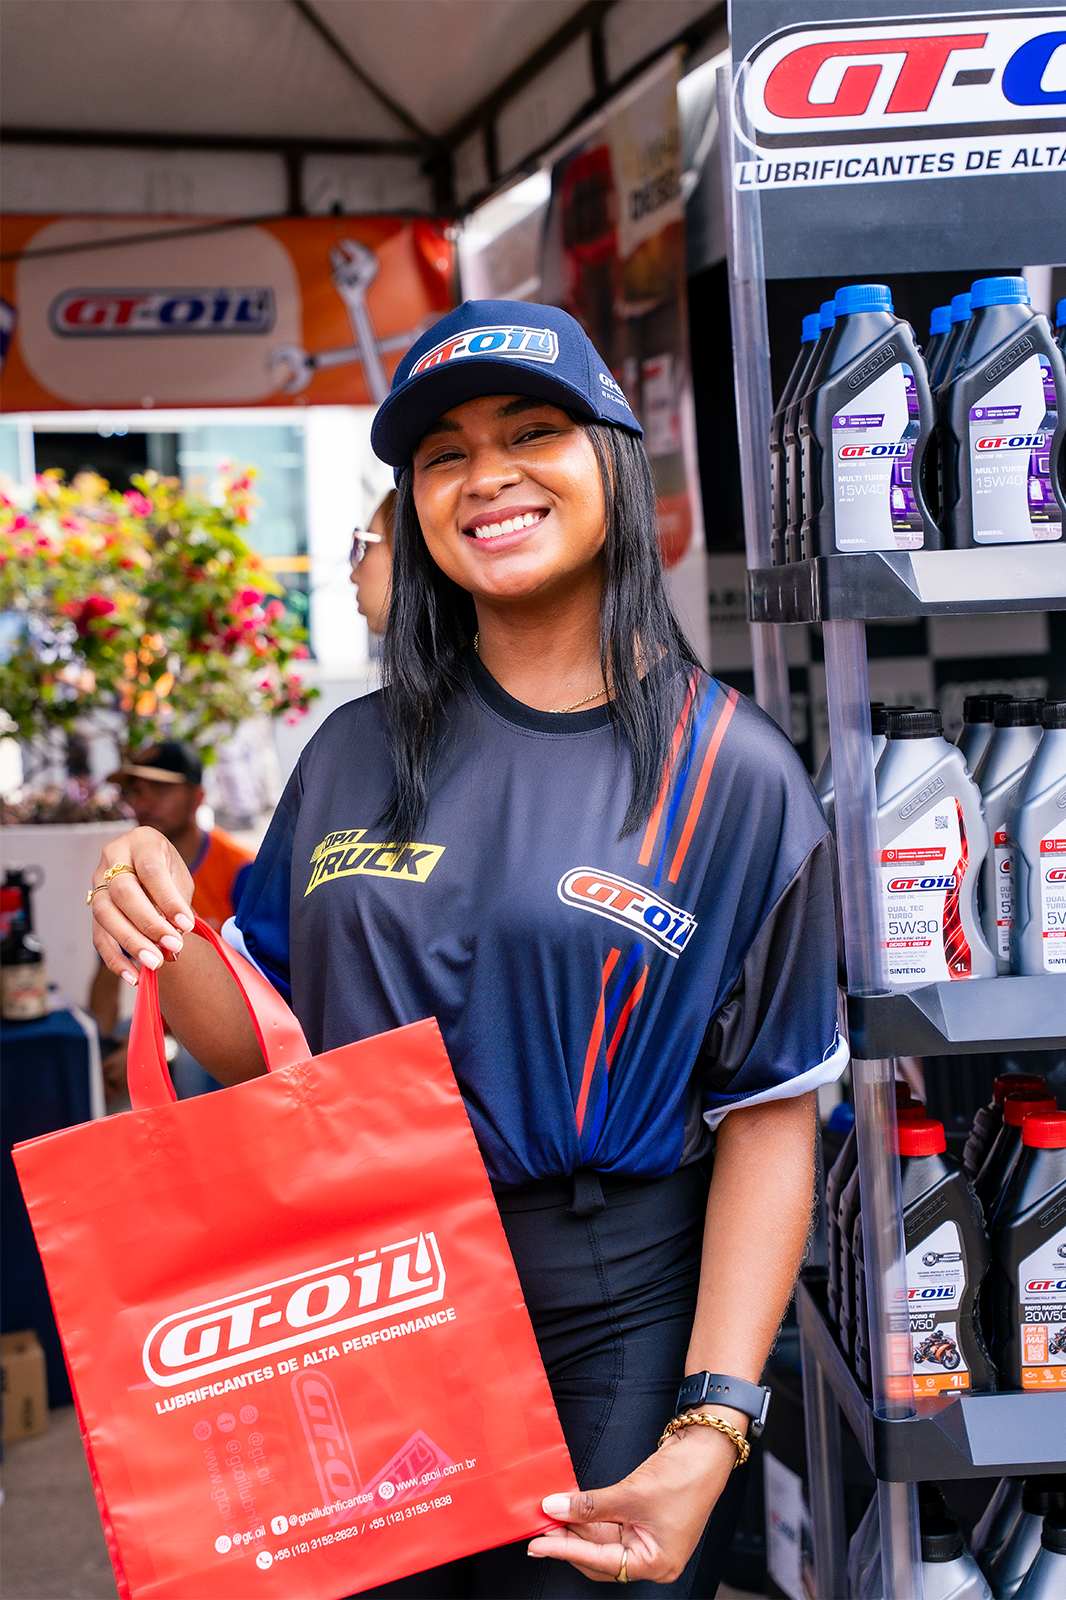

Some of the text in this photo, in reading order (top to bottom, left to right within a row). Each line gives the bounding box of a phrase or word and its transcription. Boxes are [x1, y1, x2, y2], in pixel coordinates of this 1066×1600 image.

[739, 153, 954, 186] LUBRIFICANTES
[965, 149, 1002, 170] DE
[975, 465, 1027, 475] MULTI TURBO
[838, 475, 862, 483] MULTI
[976, 475, 1024, 488] 15W40
[839, 484, 886, 496] 15W40
[888, 920, 939, 935] 5W30
[955, 963, 968, 972] 1L
[1025, 1311, 1066, 1321] 20W50
[155, 1307, 457, 1415] LUBRIFICANTES DE ALTA PERFORMANCE
[951, 1375, 966, 1387] 1L
[395, 1458, 477, 1491] www.gtoil.com.br
[288, 1492, 374, 1527] @gtoillubrificantes
[232, 1525, 266, 1545] @gt.oil
[274, 1548, 291, 1561] +55
[292, 1542, 310, 1557] (12)
[369, 1518, 385, 1530] +55
[386, 1511, 404, 1526] (12)
[405, 1495, 453, 1518] 3153-1838
